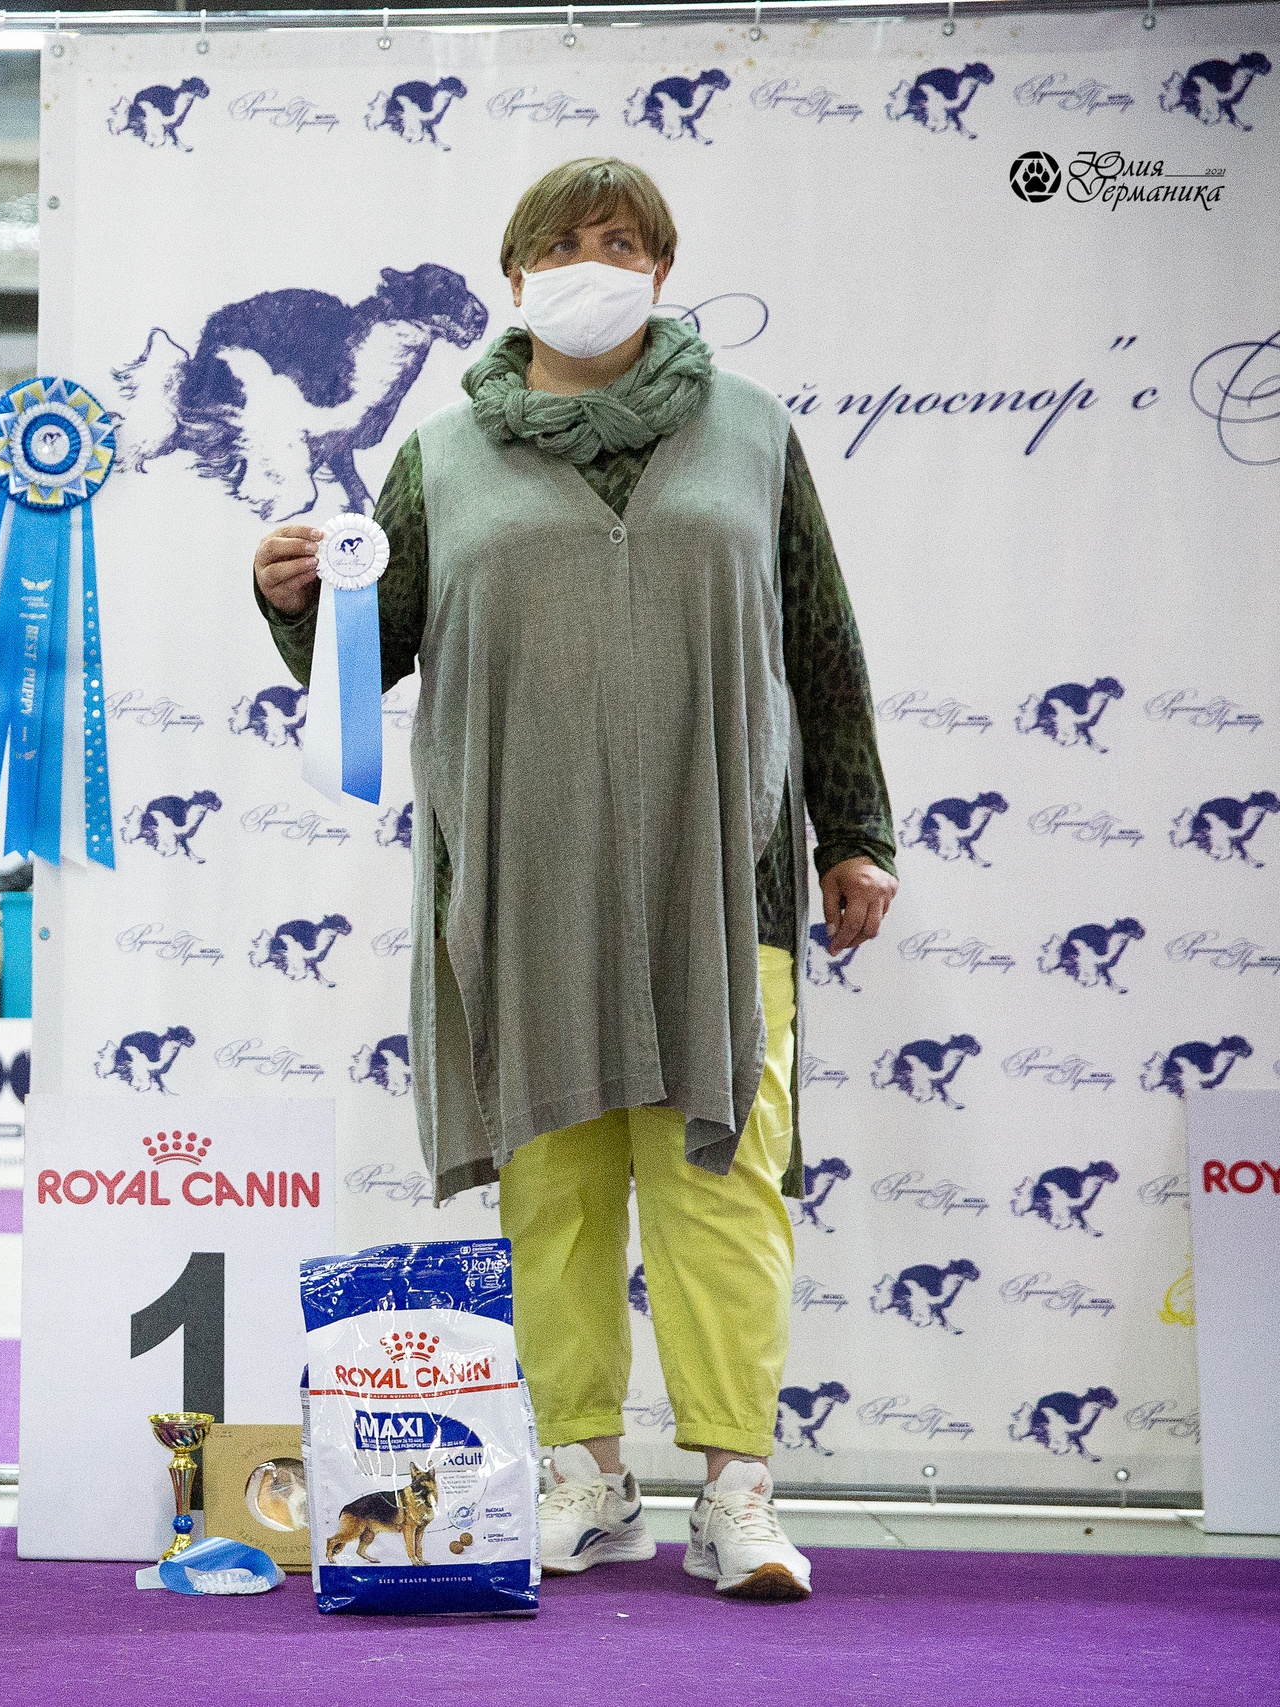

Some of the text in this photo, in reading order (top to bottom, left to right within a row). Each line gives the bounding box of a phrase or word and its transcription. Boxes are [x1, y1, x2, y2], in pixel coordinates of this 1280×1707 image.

[21, 624, 40, 715] BEST PUPPY
[37, 1169, 320, 1208] ROYAL CANIN
[1203, 1160, 1280, 1194] ROY
[461, 1259, 469, 1271] 3
[130, 1252, 224, 1510] 1
[335, 1357, 491, 1389] ROYAL CANIN
[361, 1417, 424, 1438] MAXI
[443, 1452, 482, 1466] Adult
